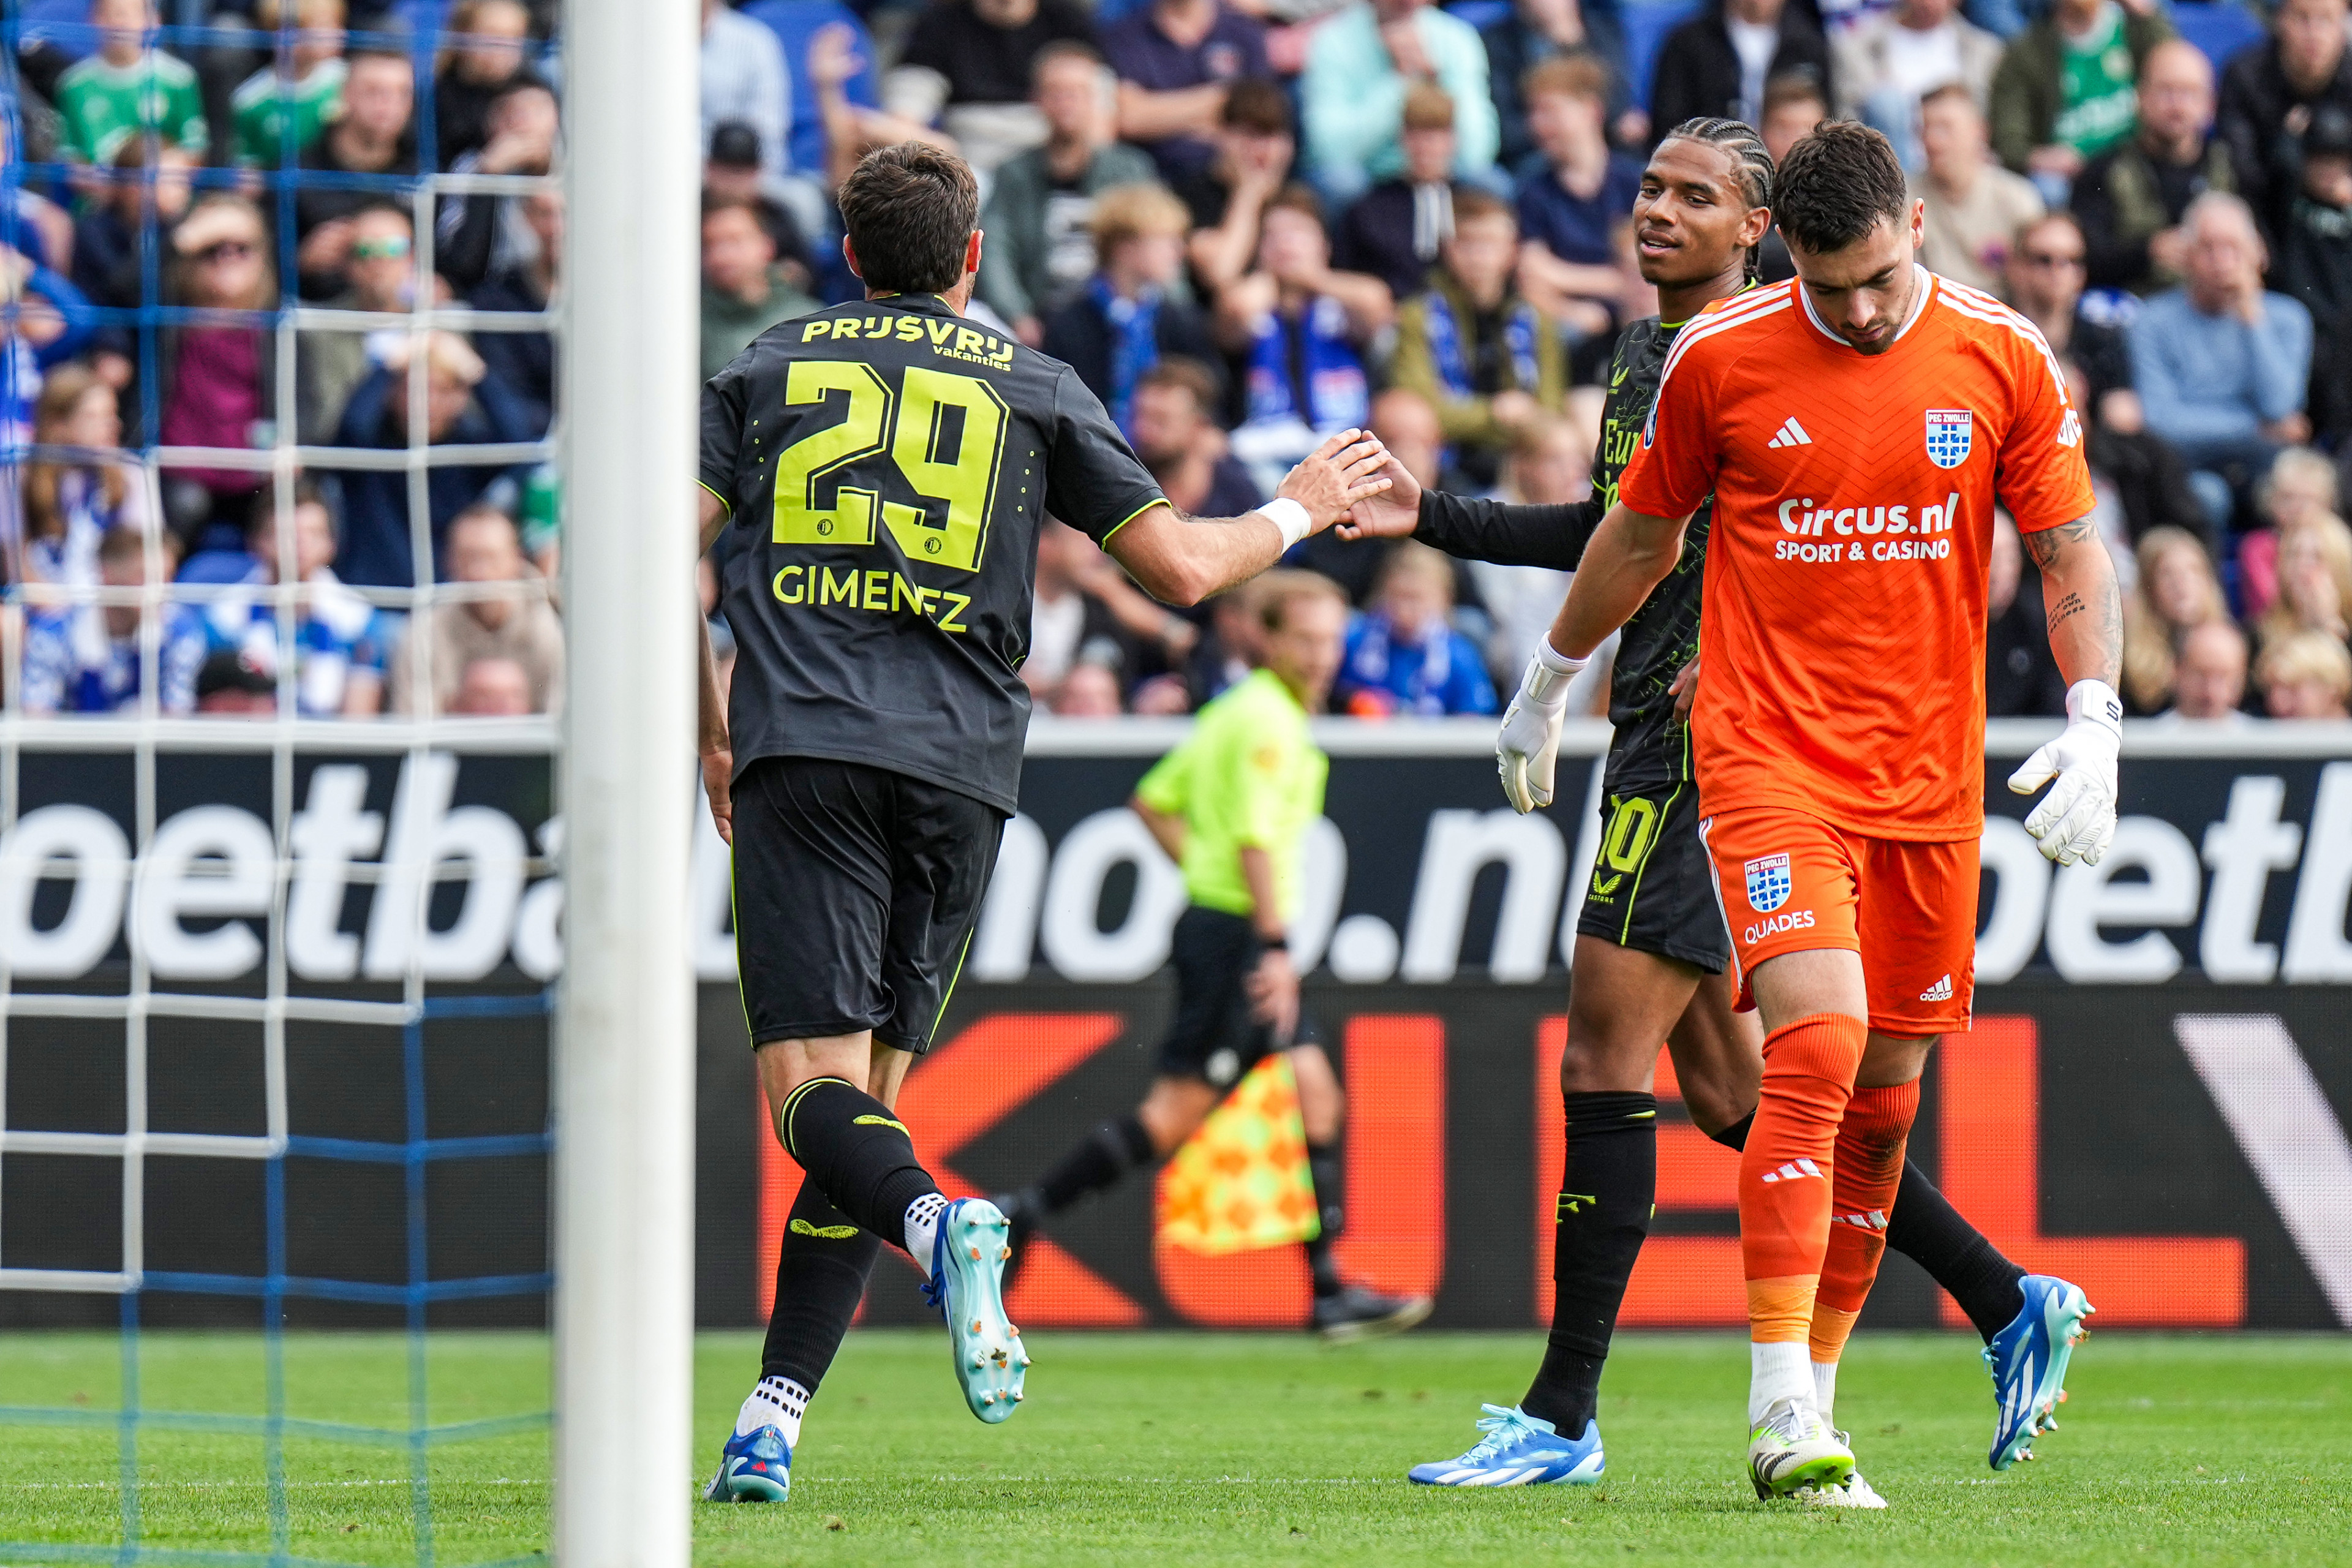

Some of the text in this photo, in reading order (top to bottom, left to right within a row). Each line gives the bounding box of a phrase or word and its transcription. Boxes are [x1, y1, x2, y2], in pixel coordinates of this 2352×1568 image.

[933, 345, 1012, 372] vakanties
[1928, 413, 1970, 423] PEC ZWOLLE
[772, 361, 1011, 573] 29
[1777, 492, 1961, 537] Circus.nl
[1774, 538, 1951, 563] SPORT & CASINO
[1596, 794, 1659, 874] 10
[1747, 857, 1787, 875] PEC ZWOLLE
[1588, 893, 1615, 905] CASTORE
[1744, 910, 1816, 945] QUADES
[1919, 989, 1953, 1002] adidas
